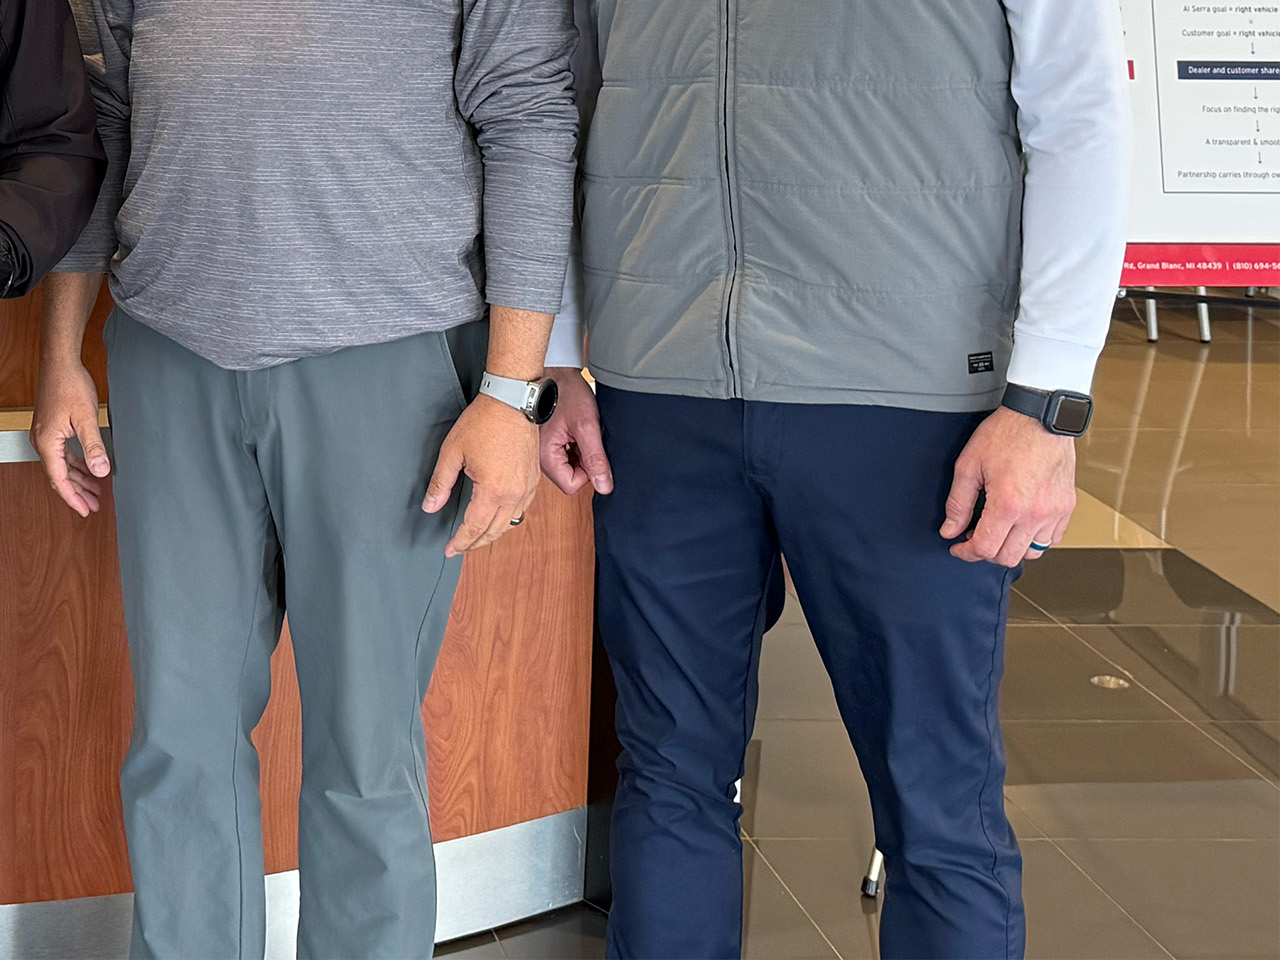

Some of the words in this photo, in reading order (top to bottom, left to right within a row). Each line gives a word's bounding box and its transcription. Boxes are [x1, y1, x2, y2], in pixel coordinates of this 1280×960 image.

[1239, 30, 1255, 38] right
[1188, 66, 1210, 74] Dealer
[1212, 66, 1225, 74] and
[1234, 106, 1256, 114] finding
[1243, 171, 1269, 179] through
